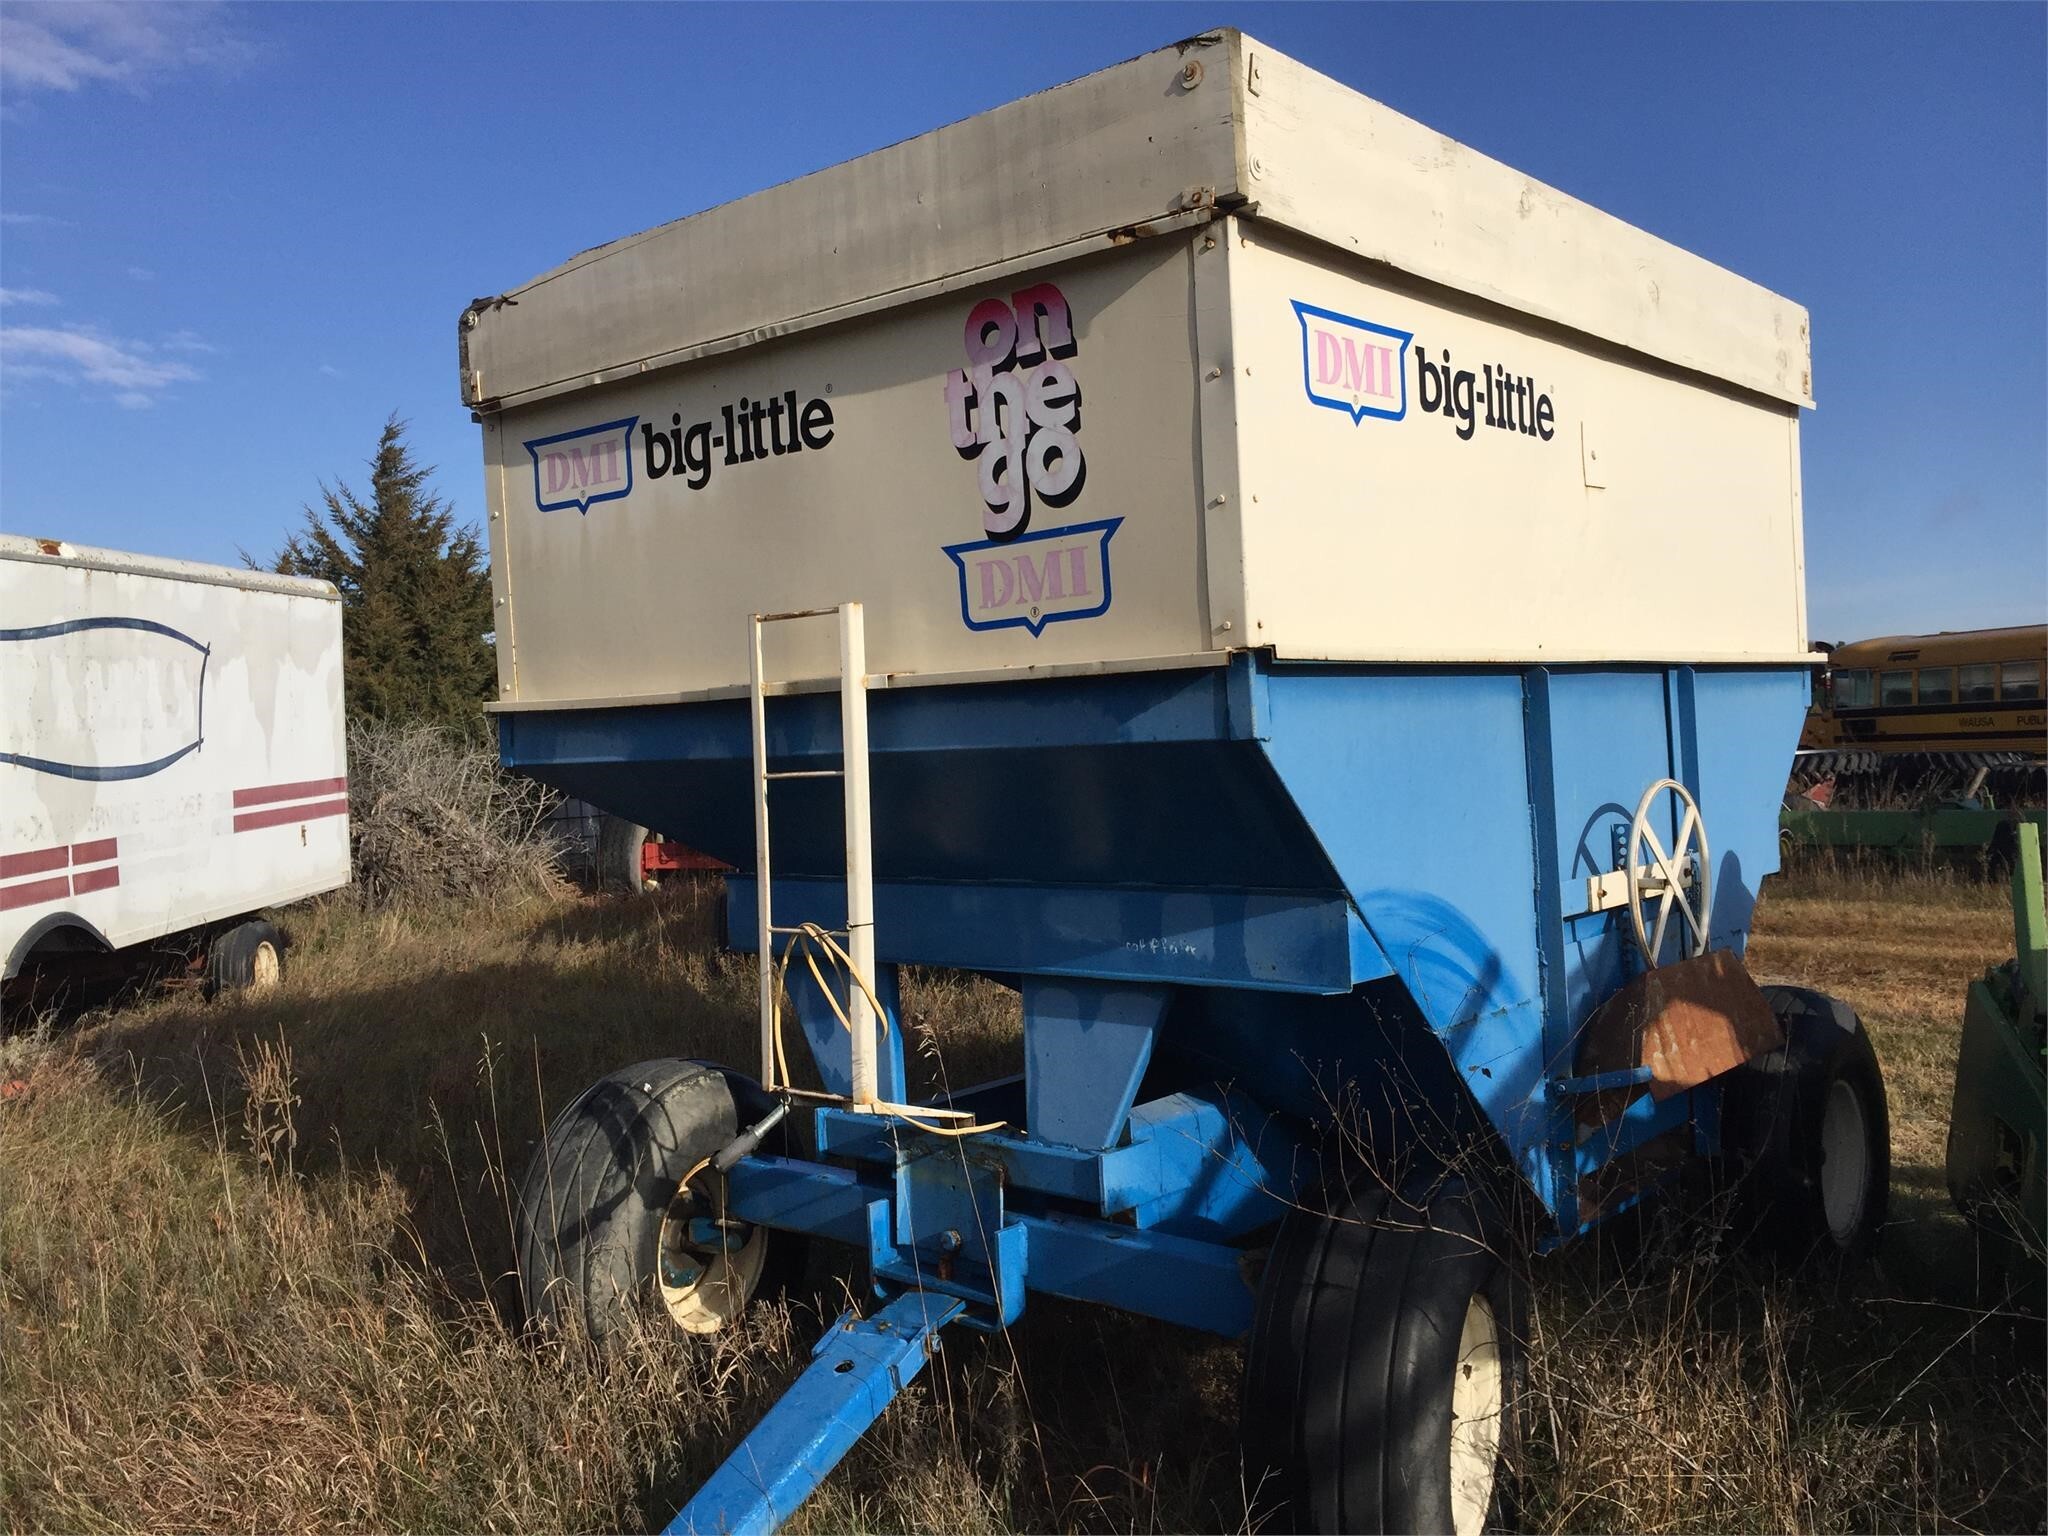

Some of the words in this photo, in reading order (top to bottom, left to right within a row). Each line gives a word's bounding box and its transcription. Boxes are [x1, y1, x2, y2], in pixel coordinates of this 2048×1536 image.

[965, 282, 1078, 374] on
[944, 357, 1082, 460] the
[1314, 329, 1395, 399] DMI
[1415, 345, 1555, 442] big-little
[545, 439, 621, 495] DMI
[641, 390, 835, 491] big-little
[977, 424, 1087, 542] go
[976, 545, 1092, 610] DMI
